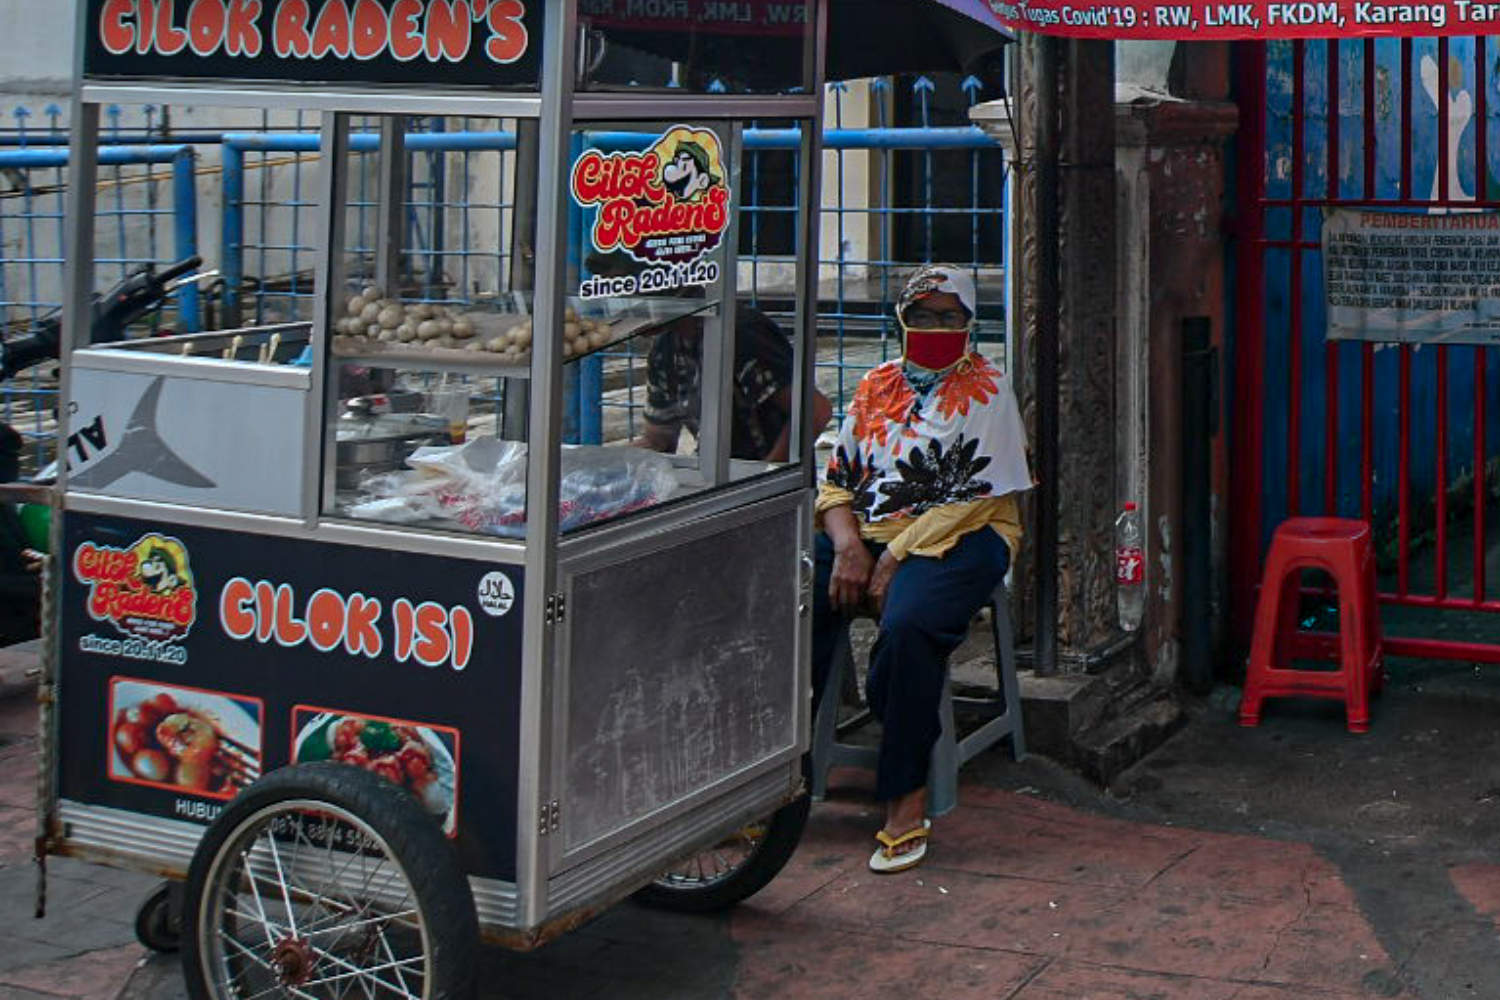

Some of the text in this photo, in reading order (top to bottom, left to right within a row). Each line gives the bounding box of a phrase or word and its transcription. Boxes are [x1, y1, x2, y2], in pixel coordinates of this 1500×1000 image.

[1019, 2, 1061, 26] Tugas
[1062, 5, 1137, 28] Covid'19
[1155, 5, 1199, 31] RW,
[1204, 4, 1260, 30] LMK,
[1267, 2, 1346, 28] FKDM,
[1355, 0, 1447, 26] Karang
[574, 150, 665, 202] Cilok
[581, 264, 718, 298] since 20.11.20
[220, 577, 474, 671] CILOK ISI
[80, 634, 122, 654] since
